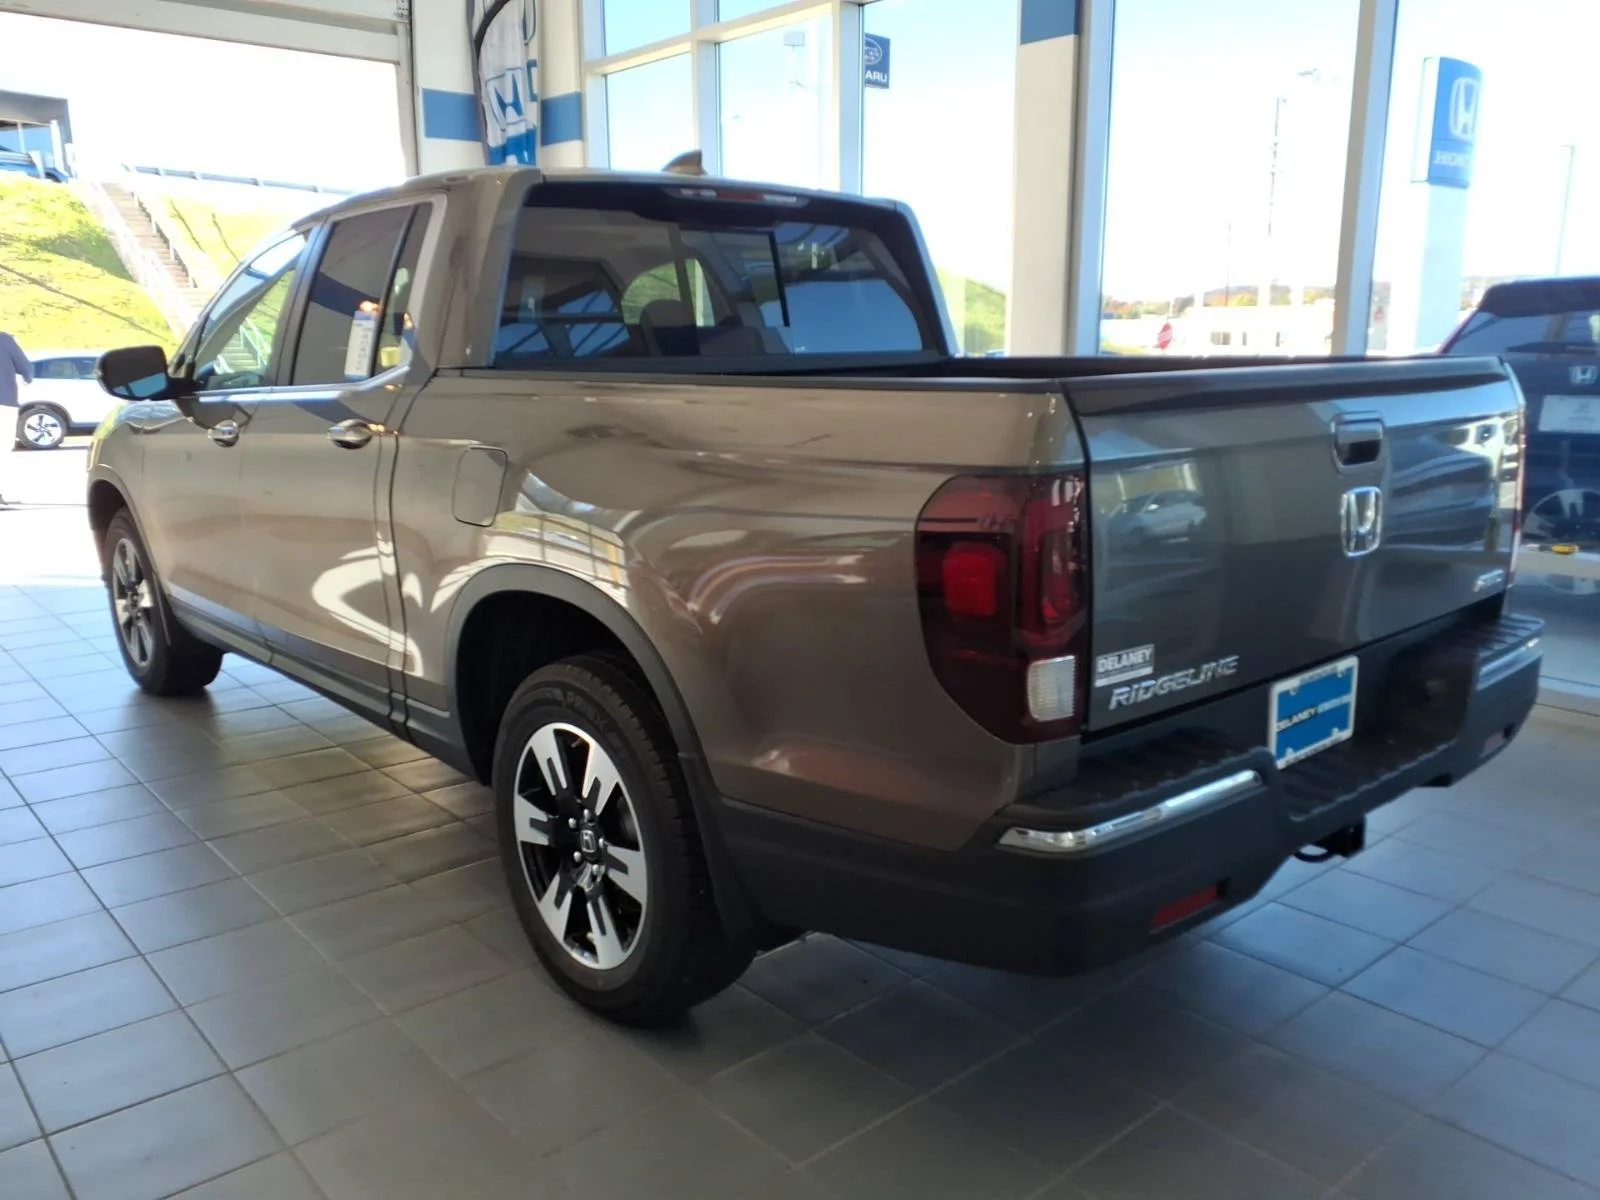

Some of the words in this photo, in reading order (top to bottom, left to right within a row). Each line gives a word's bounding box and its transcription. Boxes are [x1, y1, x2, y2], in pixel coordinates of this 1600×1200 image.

[865, 70, 888, 82] ARU
[1098, 648, 1152, 673] DELANEY
[1108, 655, 1240, 710] RIDGELINE
